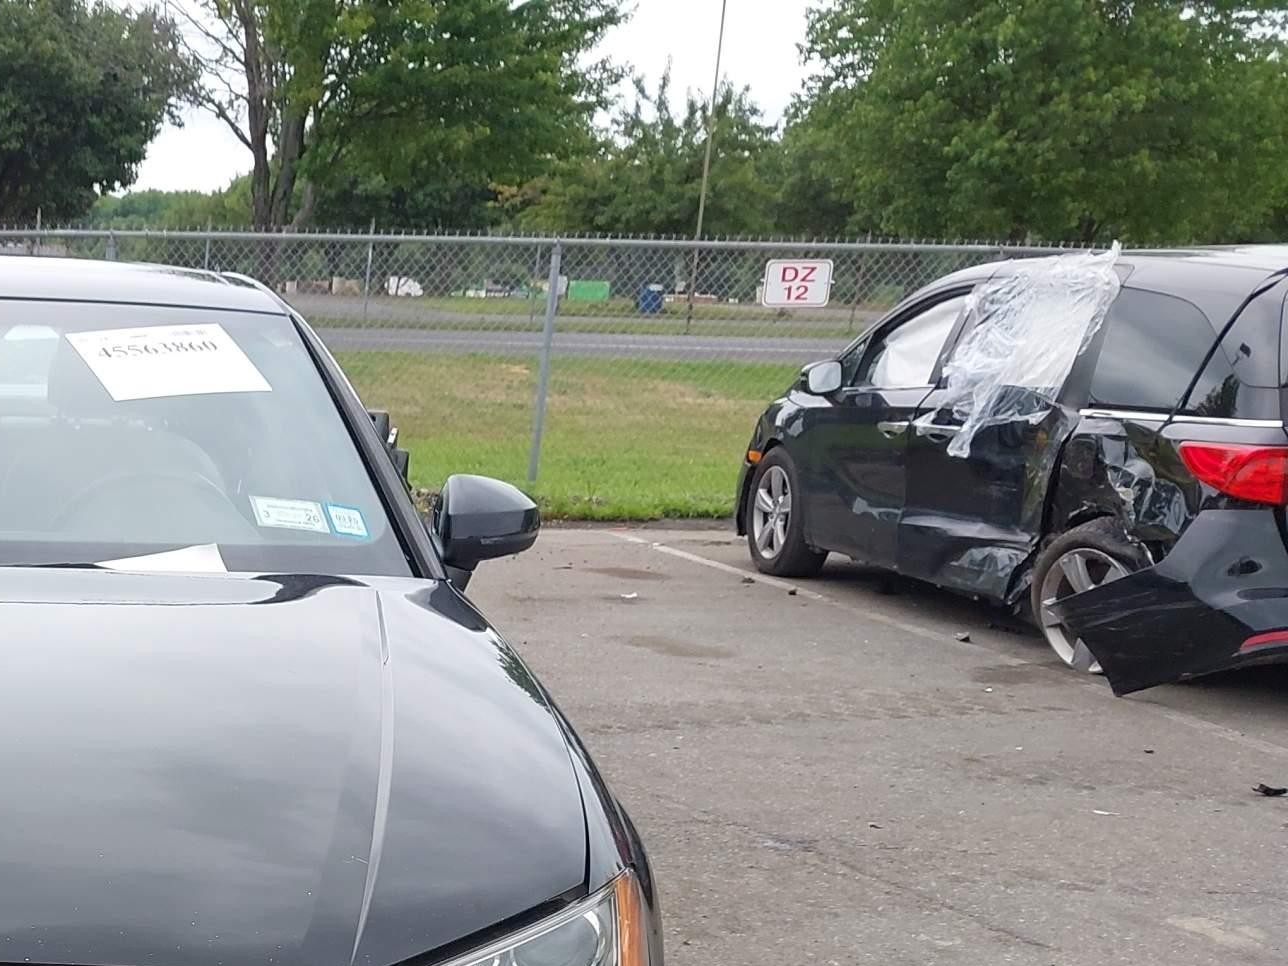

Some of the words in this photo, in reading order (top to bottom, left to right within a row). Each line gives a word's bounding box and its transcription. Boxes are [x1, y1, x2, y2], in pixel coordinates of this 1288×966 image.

[781, 266, 817, 282] DZ
[784, 285, 809, 301] 12
[98, 340, 218, 358] 45563860
